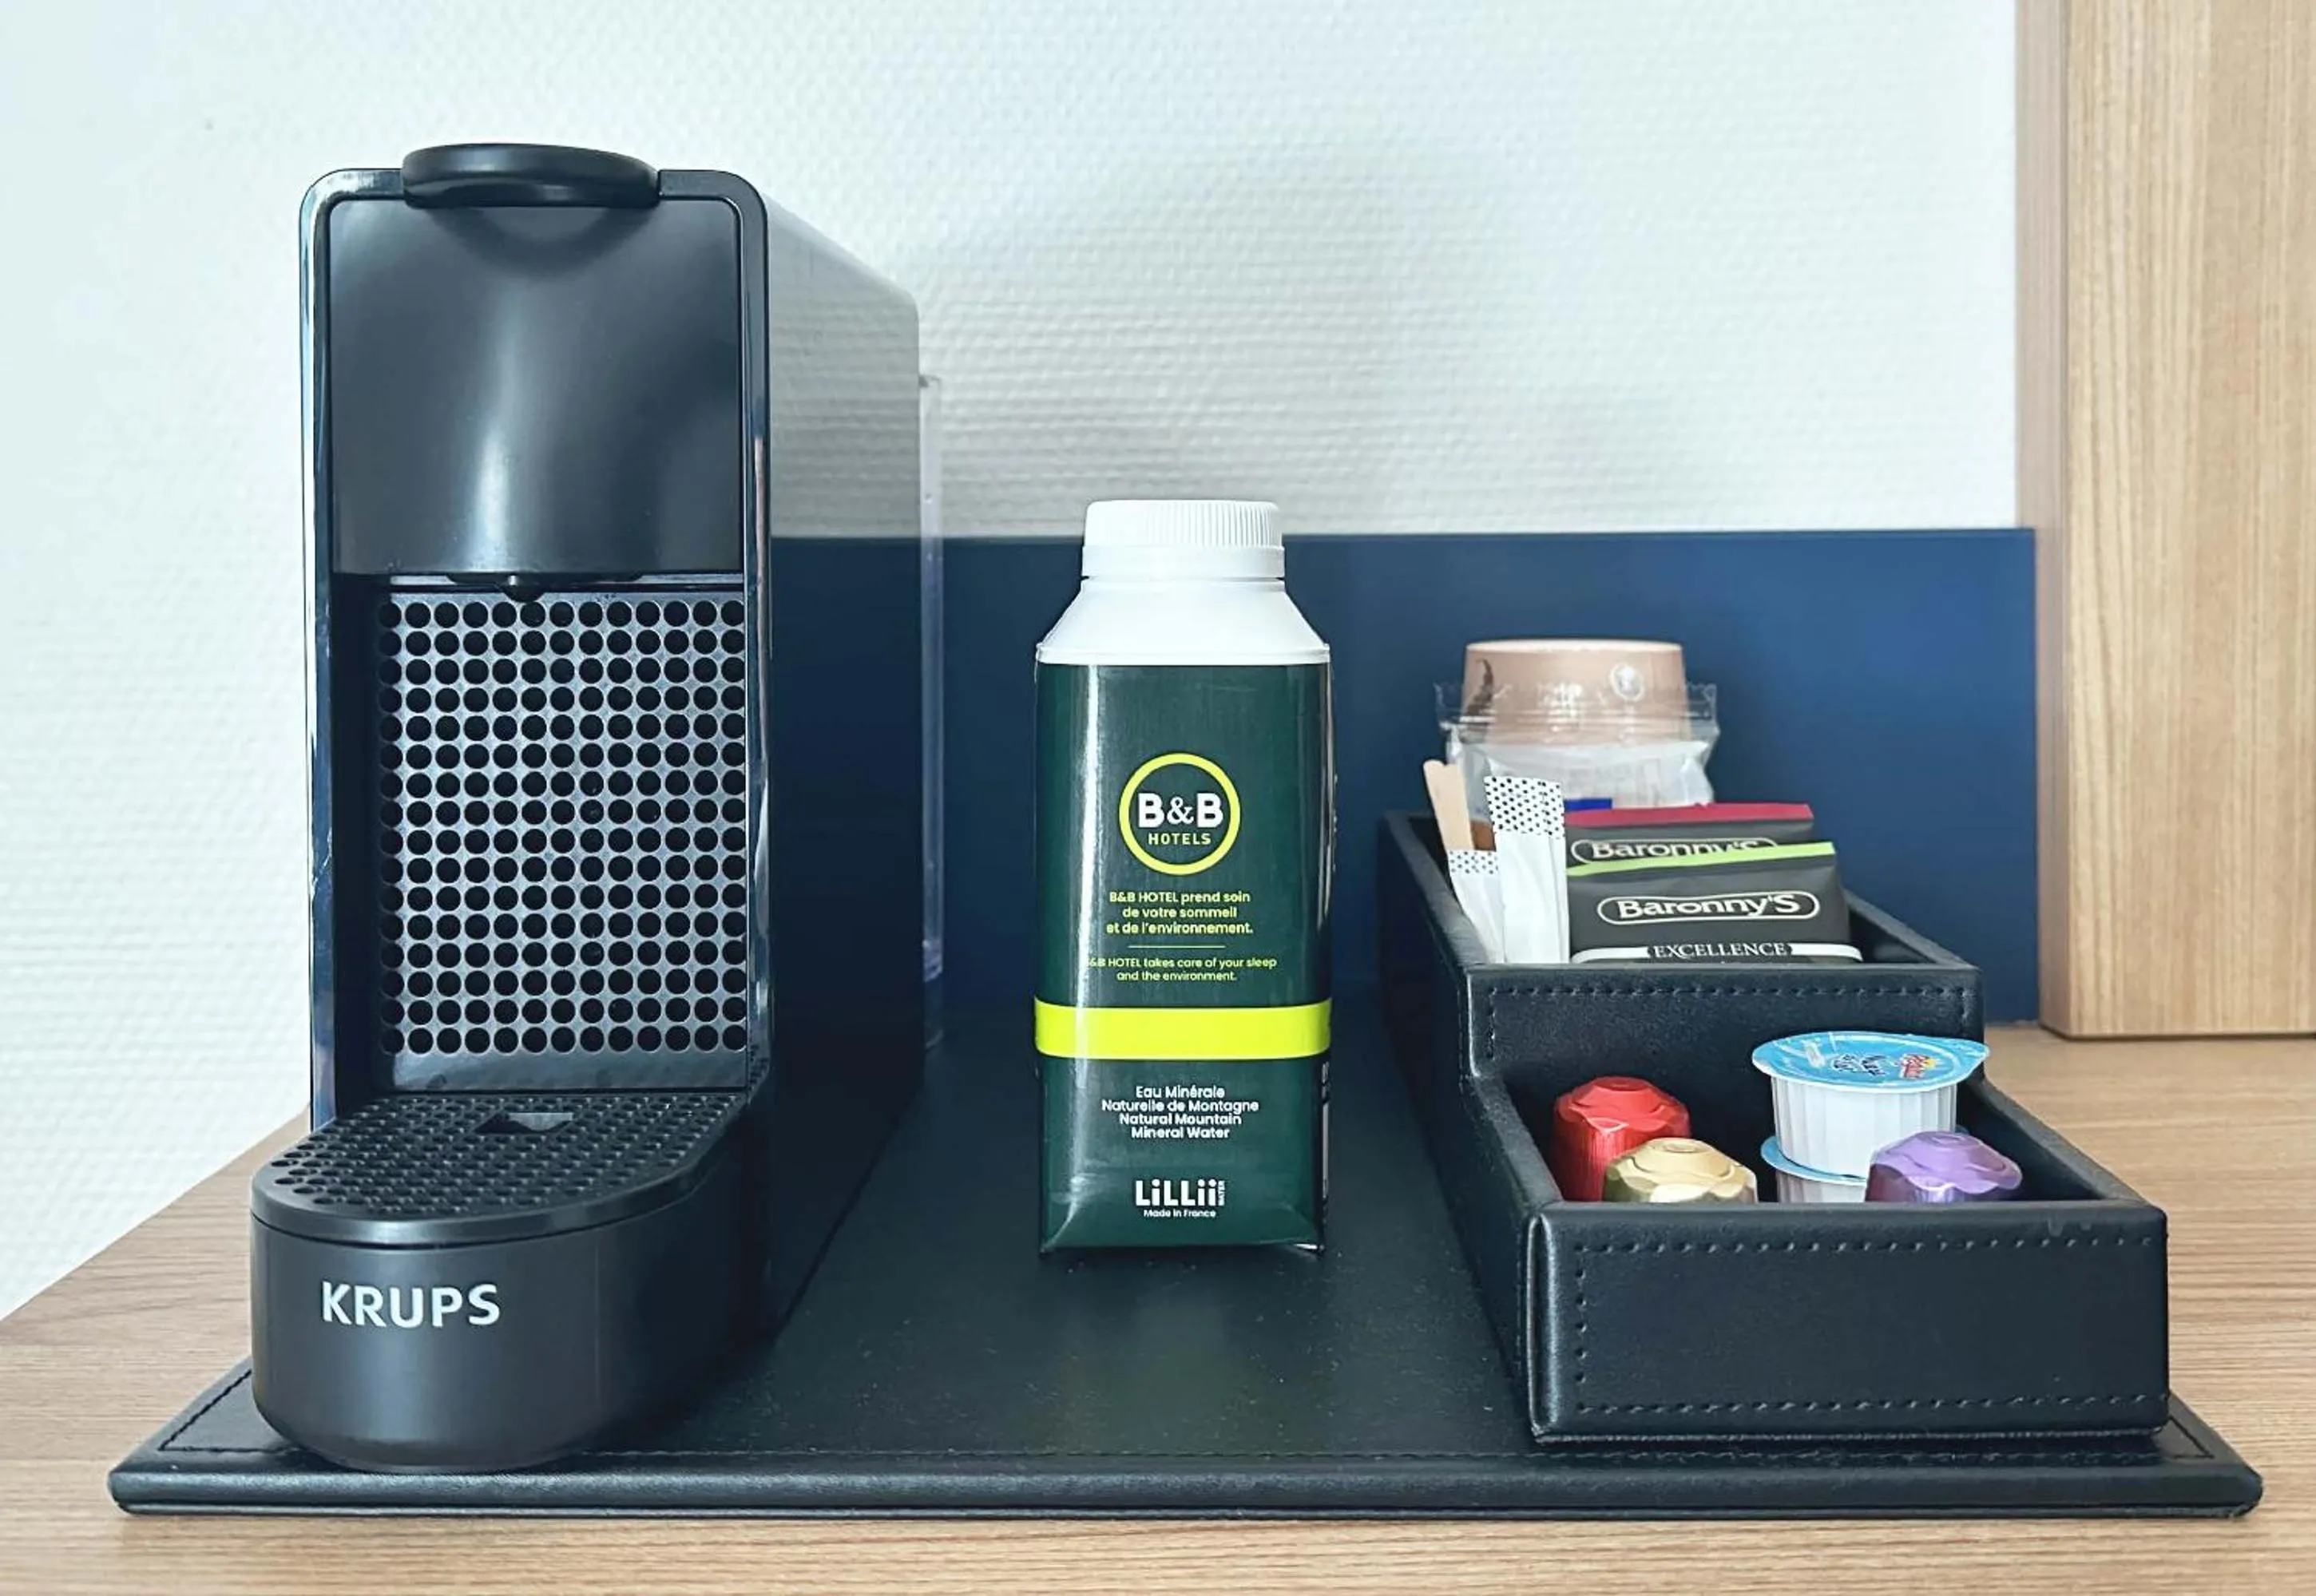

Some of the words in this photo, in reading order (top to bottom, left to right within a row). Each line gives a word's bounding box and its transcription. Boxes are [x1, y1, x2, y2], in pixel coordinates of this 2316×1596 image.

[1138, 792, 1223, 828] B&B
[1148, 833, 1212, 845] HOTELS
[1109, 892, 1135, 902] B&B
[1139, 892, 1178, 902] HOTEL
[1181, 891, 1220, 905] prend
[1223, 891, 1251, 902] soin
[1122, 907, 1139, 917] de
[1142, 908, 1177, 917] votre
[1180, 906, 1238, 917] sommeil
[1618, 894, 1801, 918] Baronny'S
[1106, 922, 1120, 933] et
[1122, 922, 1139, 933] de
[1142, 921, 1254, 934] l'environnement.
[1654, 943, 1787, 958] EXCELLENCE
[1108, 958, 1141, 968] HOTEL
[1144, 958, 1175, 968] takes
[1204, 958, 1217, 968] of
[1219, 960, 1243, 970] your
[1247, 958, 1277, 969] sleep
[1116, 971, 1139, 981] and
[1141, 971, 1160, 981] the
[1162, 971, 1237, 981] environment.
[1136, 1086, 1162, 1098] Eau
[1165, 1084, 1226, 1098] Minérale
[1101, 1099, 1164, 1111] Naturelle
[1167, 1099, 1186, 1111] de
[1188, 1099, 1259, 1115] Montagne
[1119, 1112, 1172, 1125] Natural
[1175, 1112, 1242, 1125] Mountain
[1131, 1126, 1184, 1139] Mineral
[1187, 1127, 1231, 1139] Water
[1144, 1209, 1171, 1218] Made
[1172, 1209, 1182, 1218] in
[1184, 1209, 1216, 1218] France
[322, 1281, 501, 1328] KRUPS
